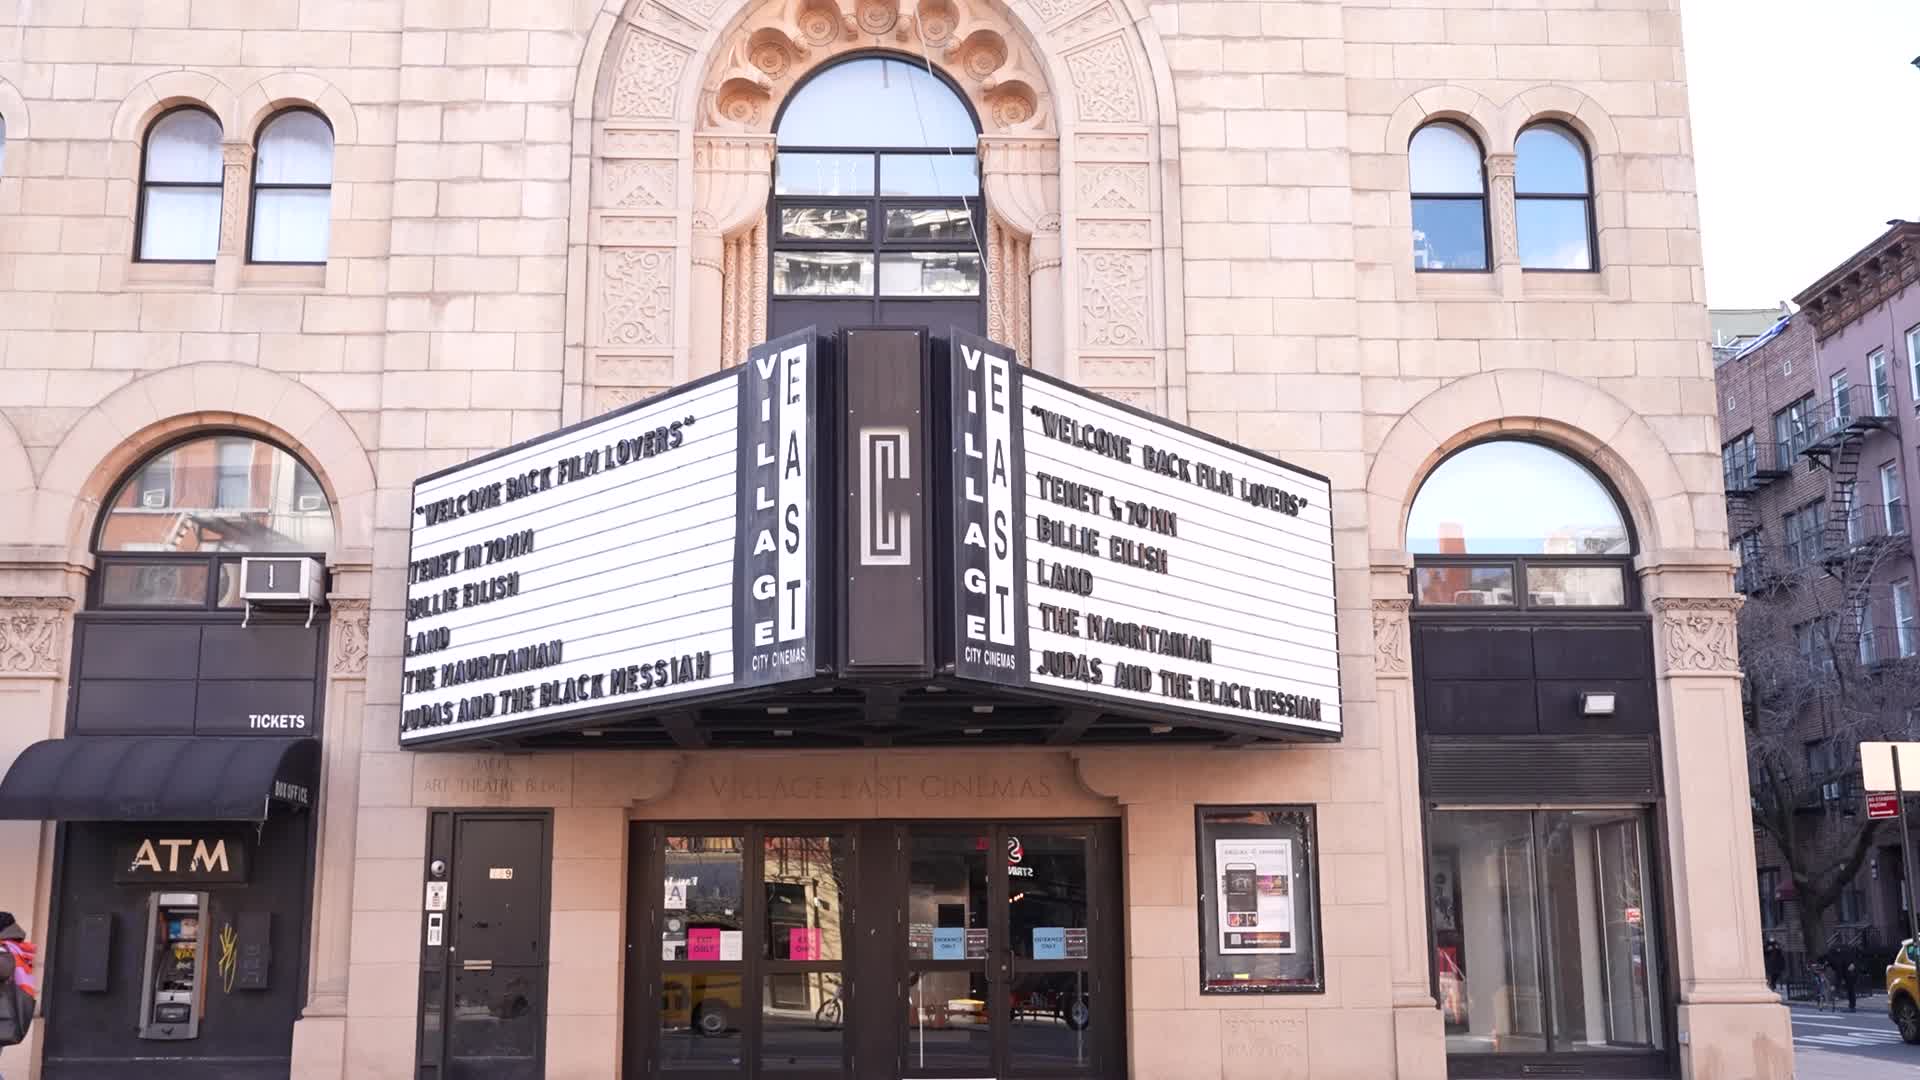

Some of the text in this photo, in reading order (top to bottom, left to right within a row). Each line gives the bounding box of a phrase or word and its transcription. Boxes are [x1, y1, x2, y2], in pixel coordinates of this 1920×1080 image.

[505, 466, 552, 503] BACK
[557, 449, 599, 485] FILM
[784, 356, 802, 630] EAST
[960, 344, 987, 640] VILLAGE
[1143, 445, 1191, 483] BACK
[1197, 461, 1234, 497] FILM
[752, 353, 777, 647] VILLAGE
[991, 365, 1009, 636] EAST
[1037, 472, 1103, 516] TENET
[1125, 500, 1177, 537] 70MM
[409, 528, 534, 585] TENET IN 70MM
[1037, 514, 1168, 575] BILLIE EILISH
[408, 571, 519, 622] BILLIE EILISH
[1037, 558, 1093, 597] LAND
[405, 627, 450, 657] LAND
[752, 647, 806, 671] CITY CINEMAS
[965, 646, 1016, 670] CITY CINEMAS
[1039, 602, 1212, 663] THE MAURITANIAN
[403, 651, 711, 732] JUDAS AND THE BLACK MESSIAH
[404, 639, 563, 694] THE MAURITANIAN
[1037, 650, 1322, 722] JUDAS AND THE BLACK MESSIAH
[249, 714, 305, 729] TICKETS
[275, 780, 308, 804] BOX OFFICE
[708, 776, 1052, 799] VILLAGE EAST CINEMAS
[128, 838, 229, 872] ATM
